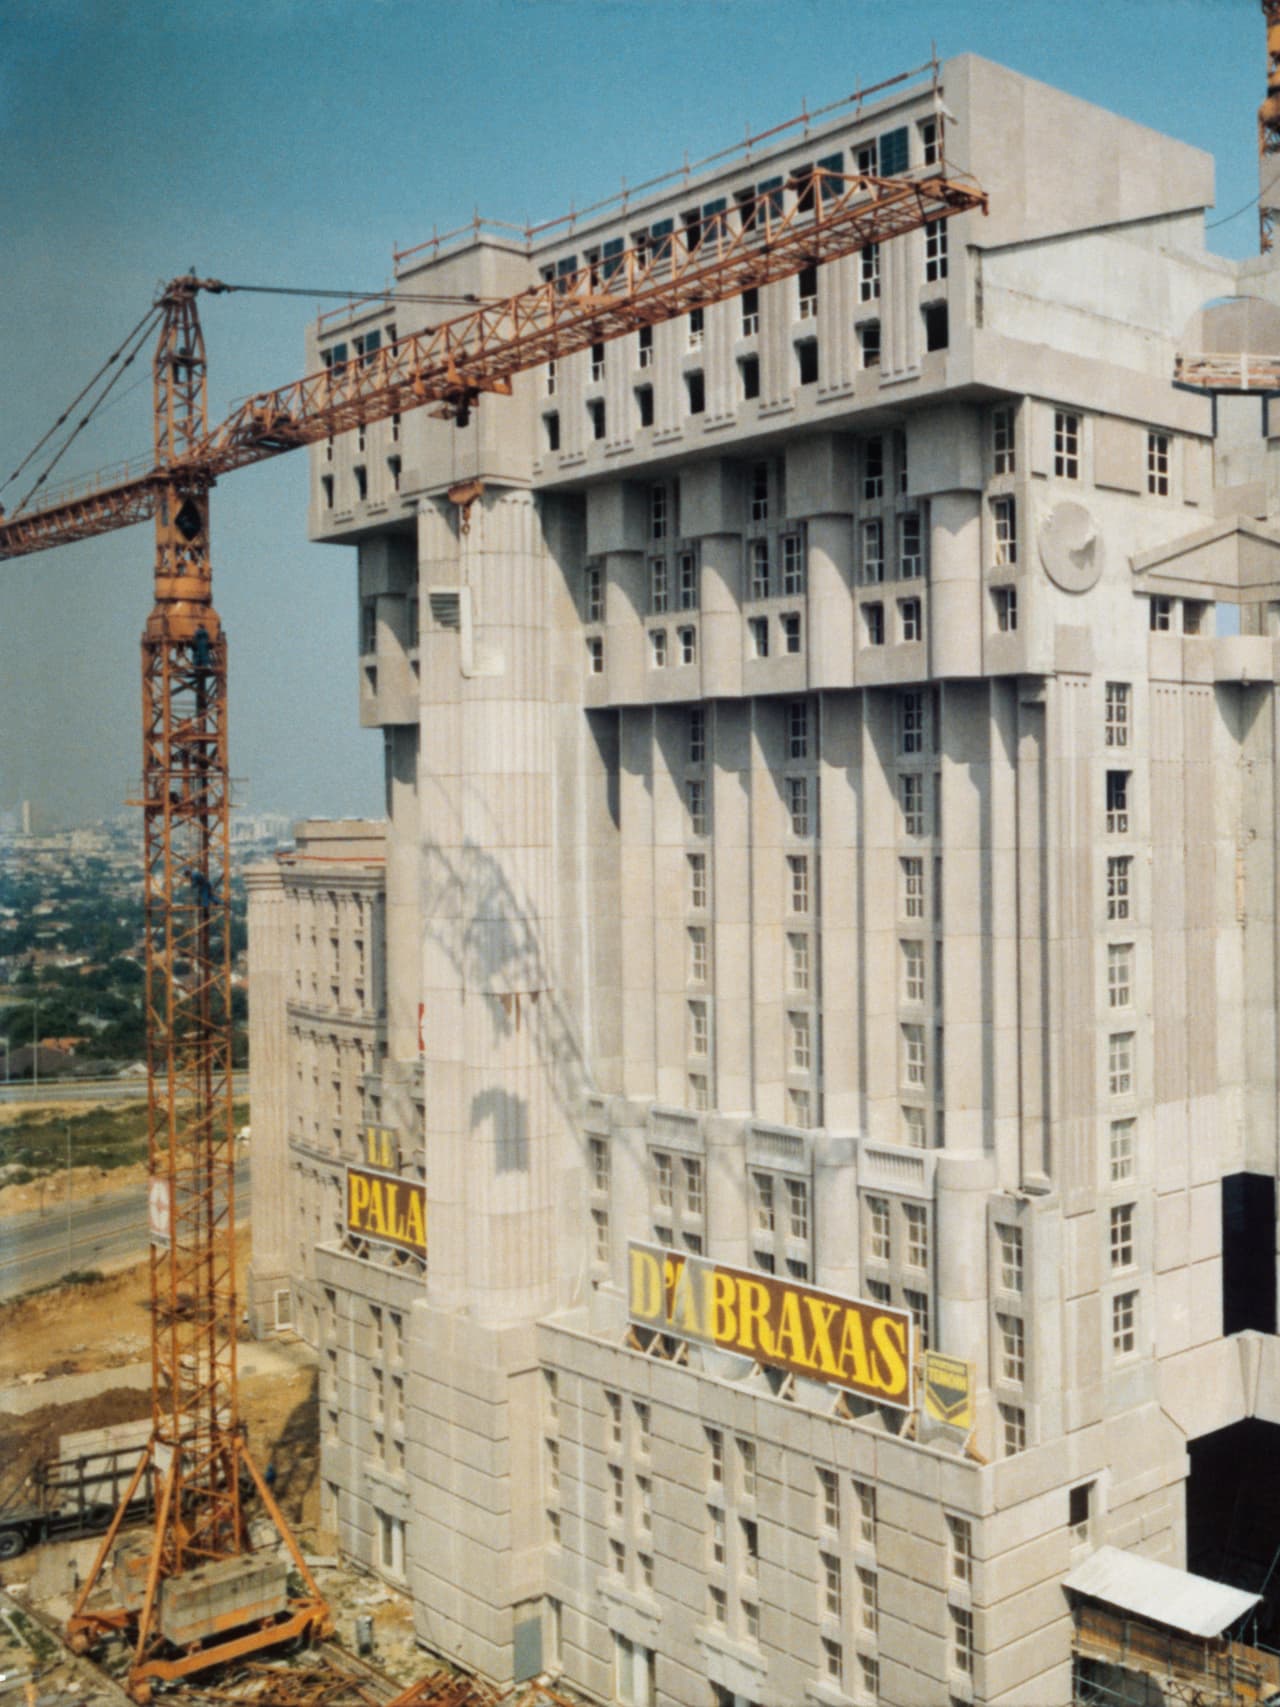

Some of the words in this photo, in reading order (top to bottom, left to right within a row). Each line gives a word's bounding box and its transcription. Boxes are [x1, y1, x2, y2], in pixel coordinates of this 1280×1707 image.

[366, 1127, 394, 1169] LE
[349, 1173, 427, 1247] PALA
[629, 1249, 906, 1394] D'ABRAXAS
